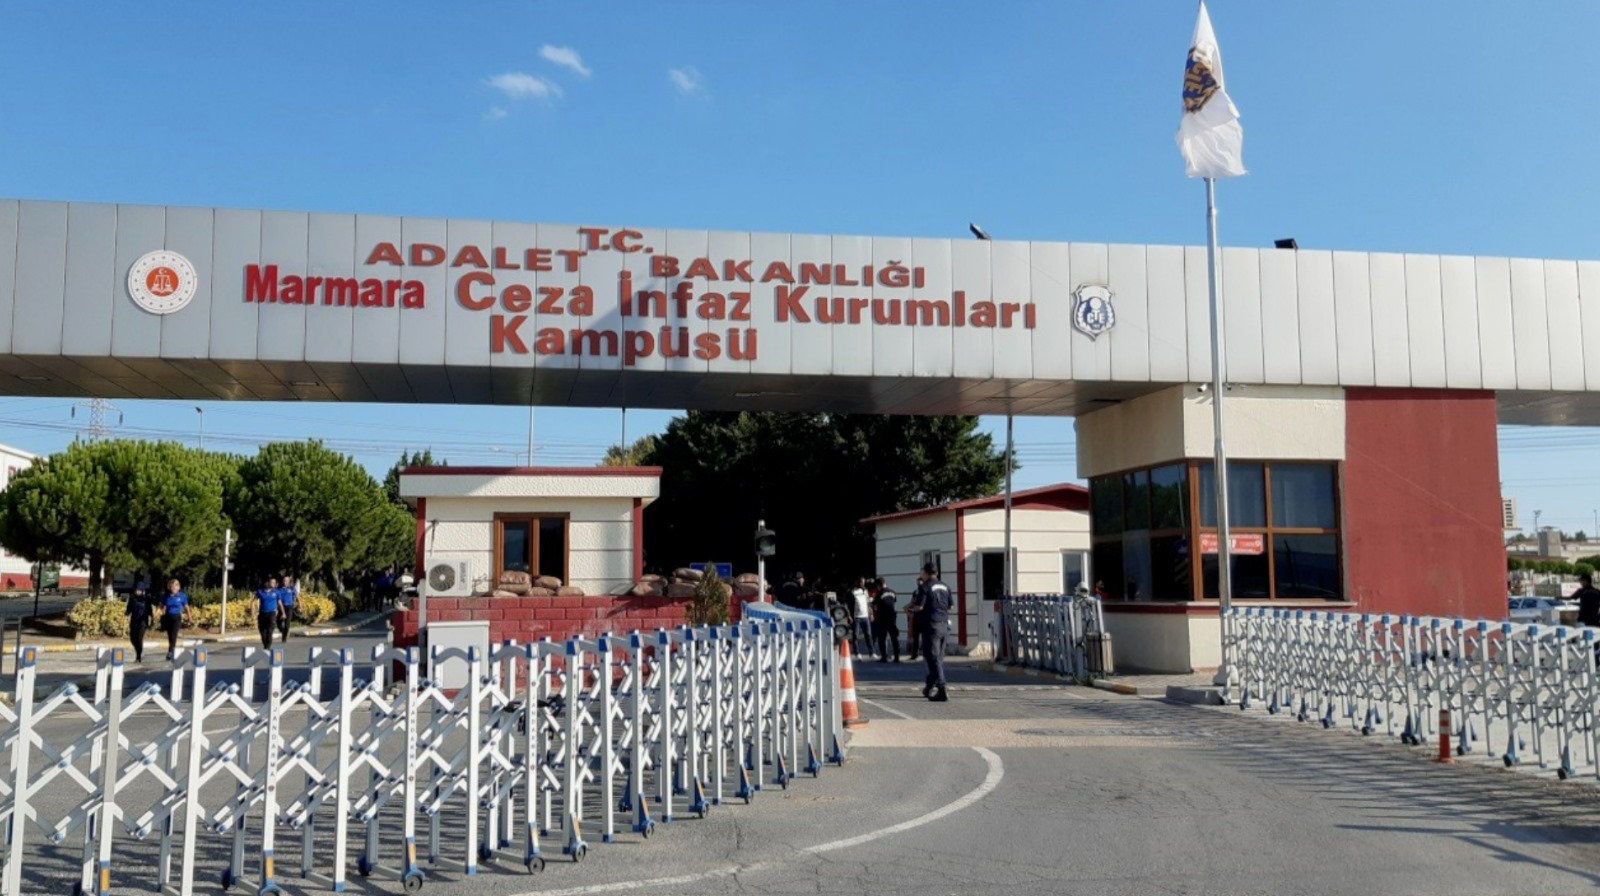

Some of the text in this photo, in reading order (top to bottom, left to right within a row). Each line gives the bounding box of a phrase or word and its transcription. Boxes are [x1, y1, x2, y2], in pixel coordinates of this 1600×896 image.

[366, 242, 925, 288] ADALET BAKANLIĞI
[579, 228, 653, 253] T.C.
[245, 263, 425, 309] Marmara
[458, 271, 594, 315] Ceza
[776, 285, 1036, 328] Kurumları
[491, 314, 757, 366] Kampüsü
[270, 706, 278, 777] JANDARMA
